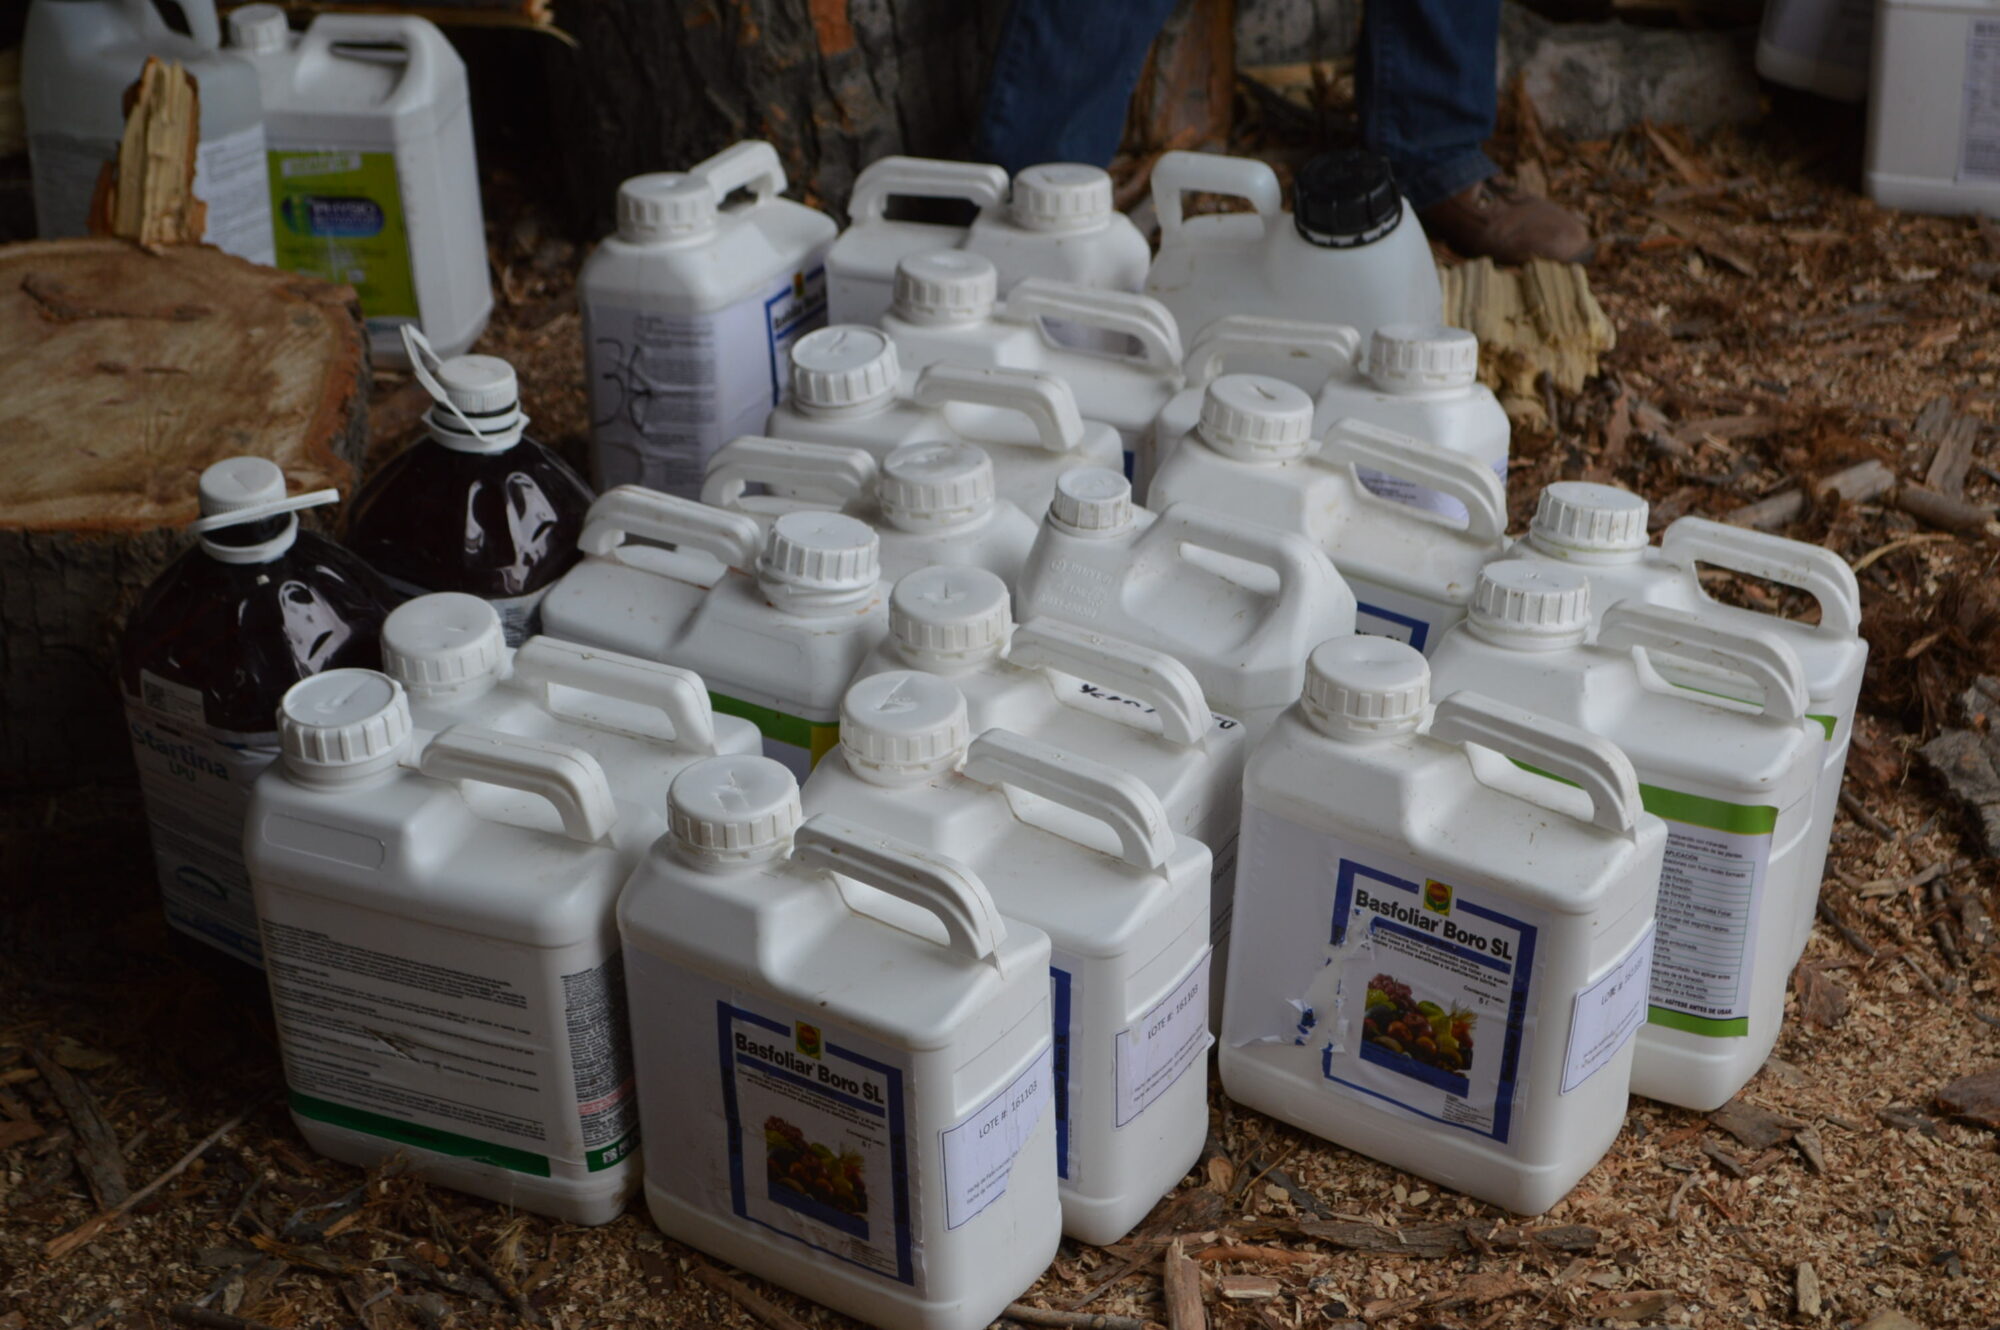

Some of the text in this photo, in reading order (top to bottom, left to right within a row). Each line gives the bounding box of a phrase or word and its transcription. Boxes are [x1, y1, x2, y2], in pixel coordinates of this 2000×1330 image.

[131, 720, 229, 780] Startina
[1443, 920, 1487, 951] Boro
[1490, 940, 1512, 961] SL
[1147, 1018, 1165, 1040] LOTE
[817, 1064, 859, 1095] Boro
[863, 1083, 885, 1104] SL
[978, 1114, 1000, 1139] LOTE
[1010, 1080, 1038, 1113] 161103
